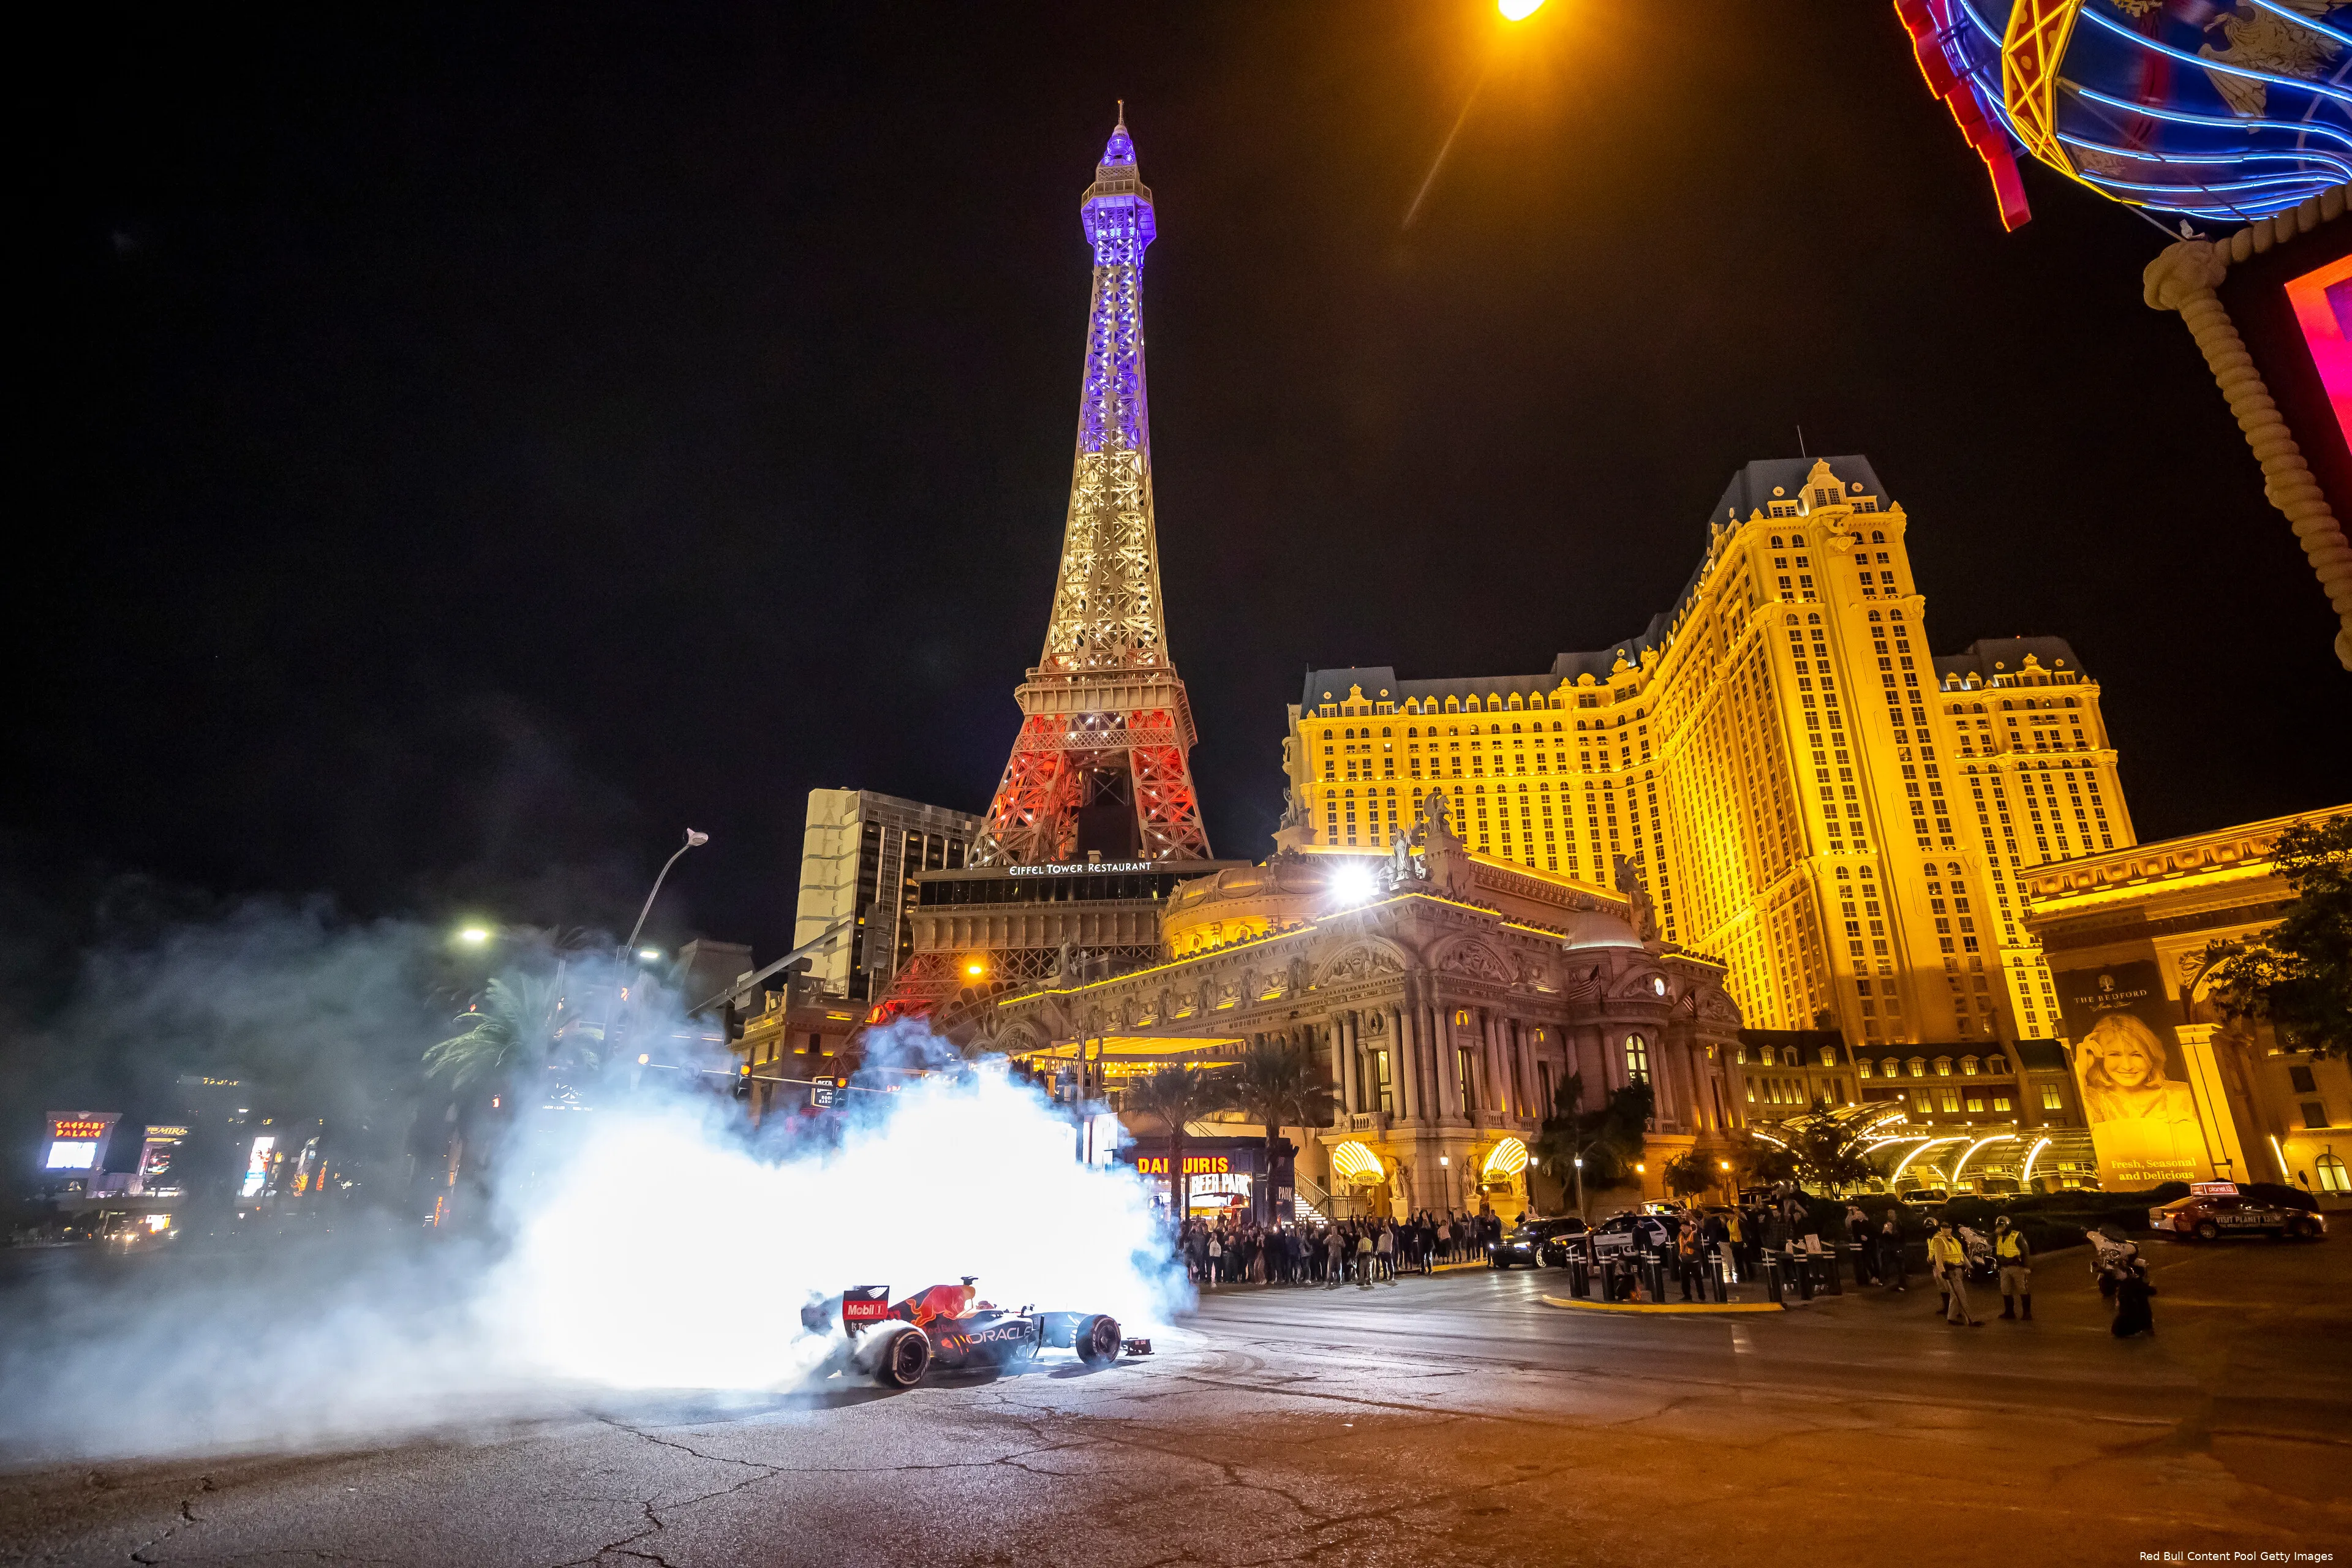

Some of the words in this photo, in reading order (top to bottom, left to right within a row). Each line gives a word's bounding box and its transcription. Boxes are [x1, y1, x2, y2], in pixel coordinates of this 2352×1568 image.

[1010, 865, 1044, 875] EIFFEL
[1047, 864, 1083, 873] TOWER
[1088, 862, 1152, 872] RESTAURANT
[2098, 990, 2147, 1001] BEDFORD
[56, 1121, 105, 1129] CAESARS
[1138, 1157, 1229, 1174] DAIUIRIS
[2111, 1159, 2145, 1169] Fresh,
[2146, 1157, 2196, 1168] Seasonal
[2119, 1171, 2141, 1180] and
[2143, 1170, 2195, 1180] Delicious
[1191, 1173, 1219, 1197] BEER
[1221, 1173, 1251, 1198] PARK
[1278, 1186, 1292, 1202] PARK
[848, 1305, 875, 1315] Mobil
[966, 1325, 1031, 1344] ORACLE
